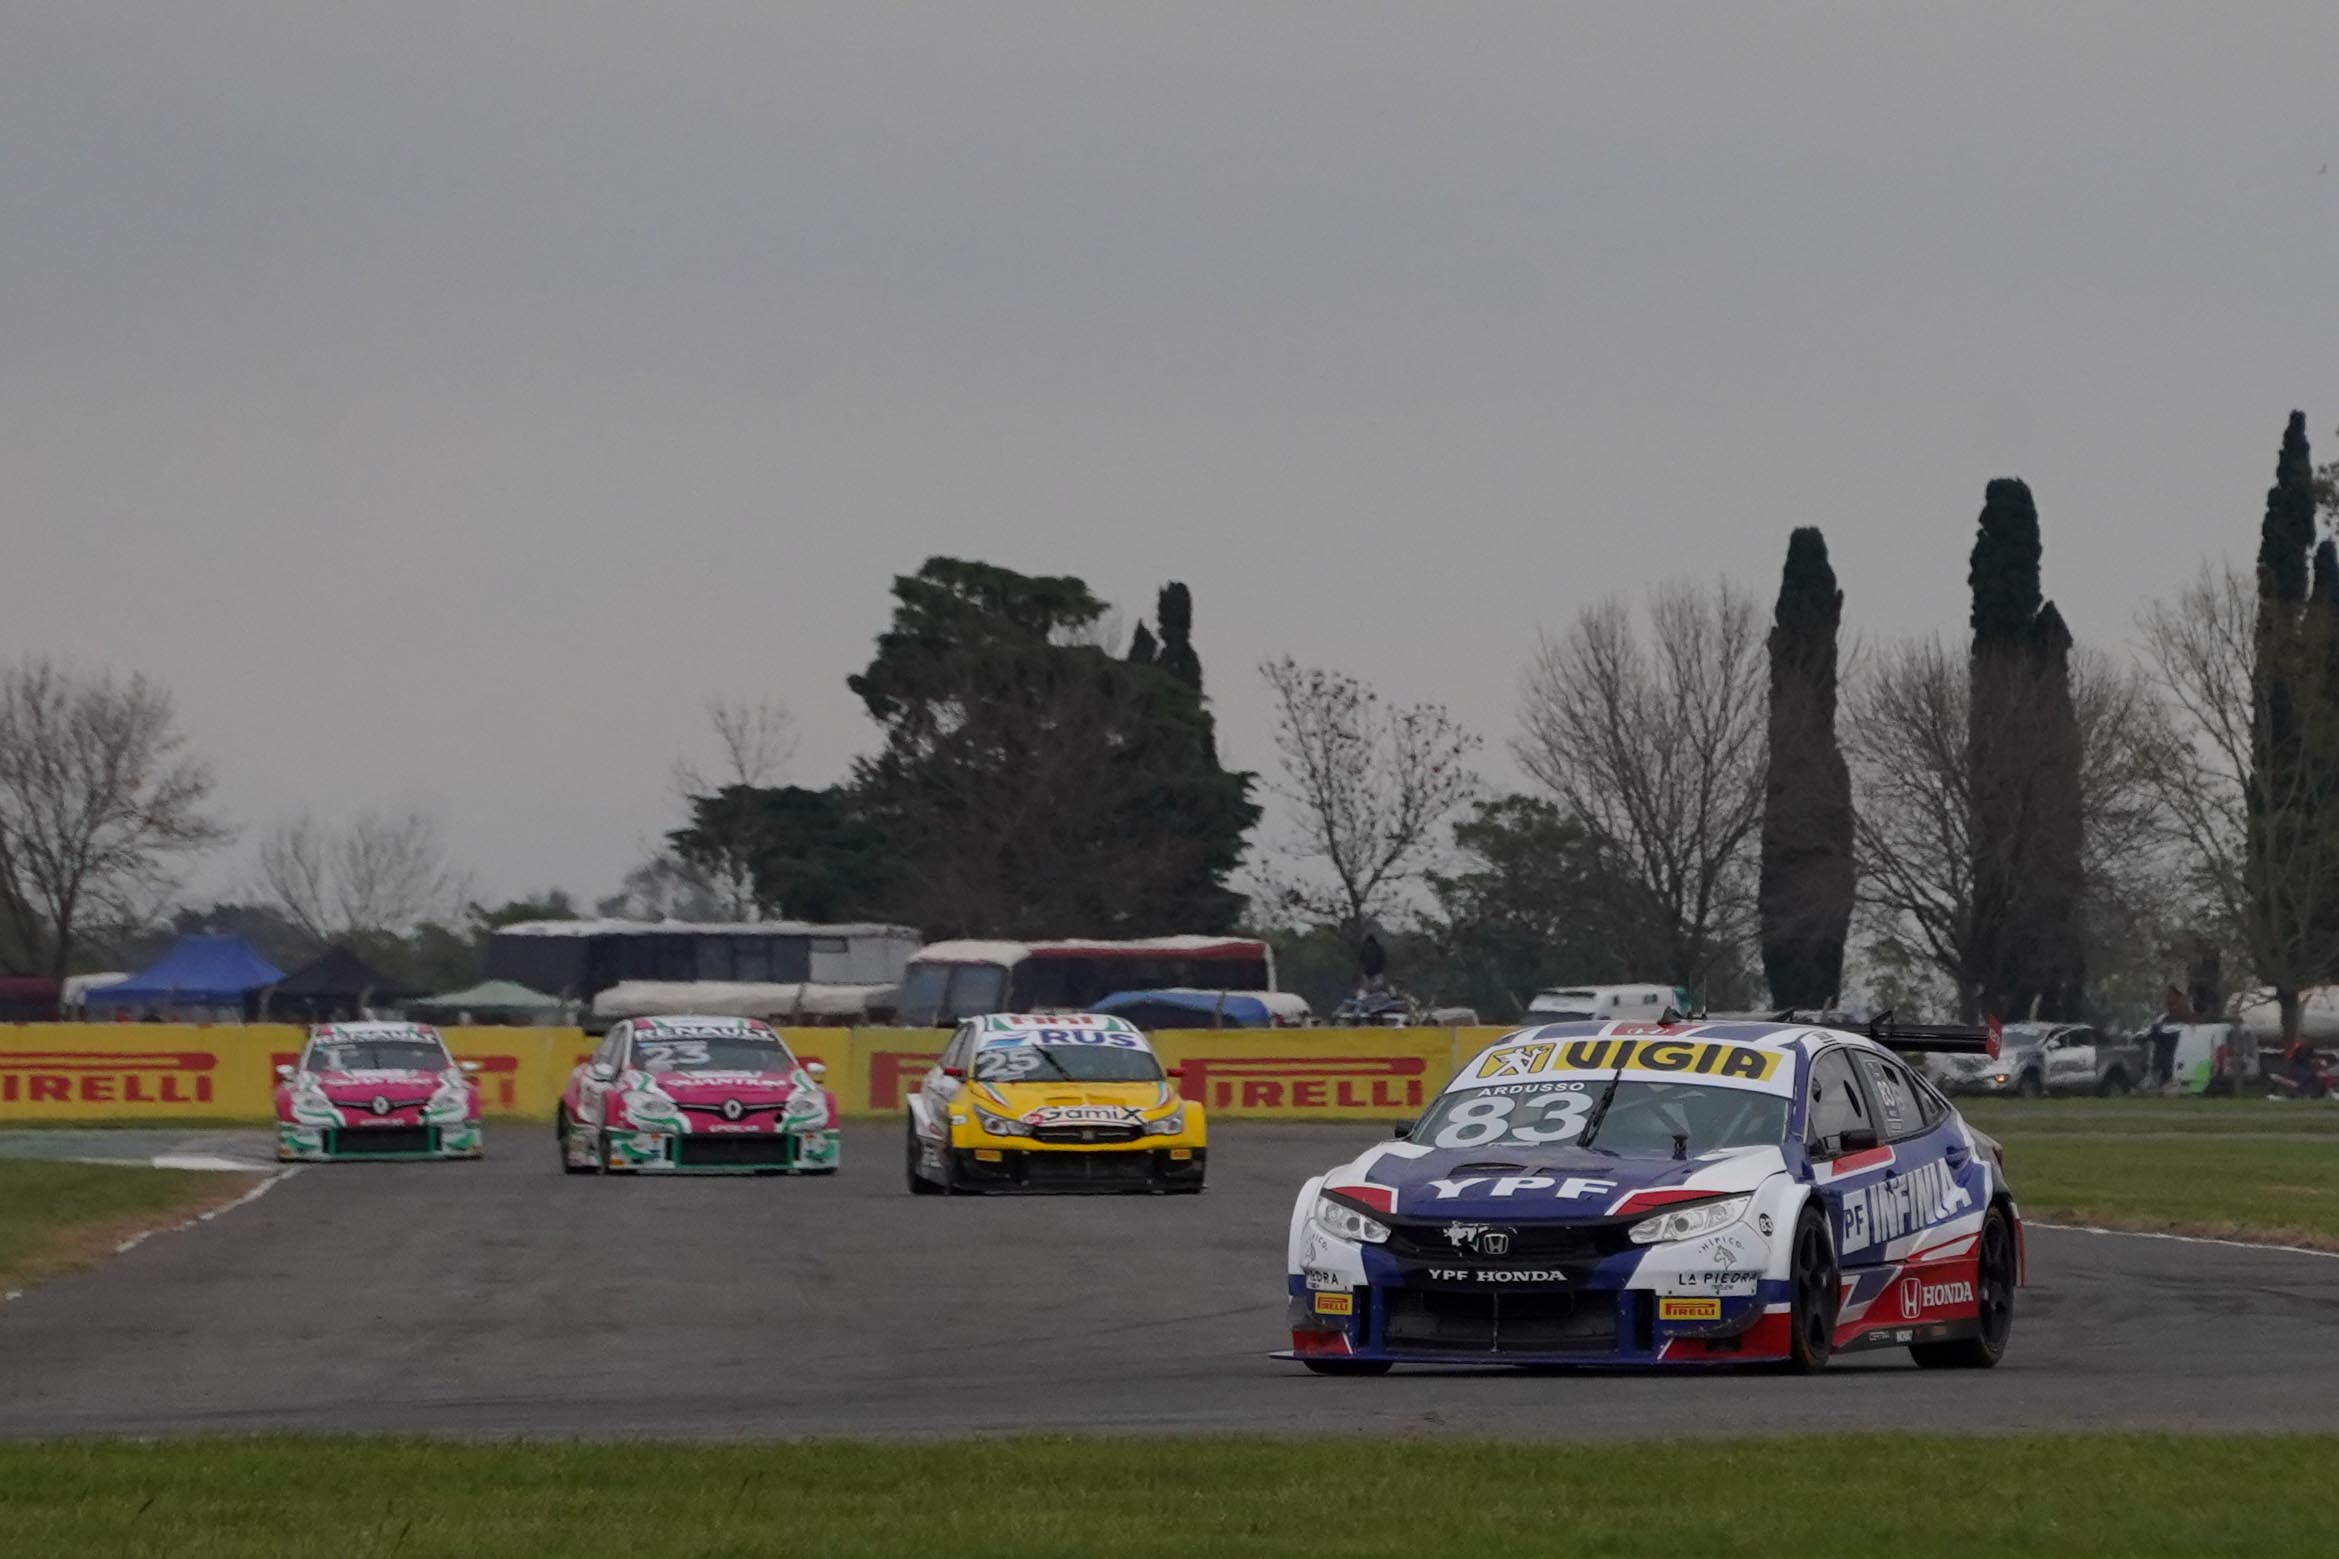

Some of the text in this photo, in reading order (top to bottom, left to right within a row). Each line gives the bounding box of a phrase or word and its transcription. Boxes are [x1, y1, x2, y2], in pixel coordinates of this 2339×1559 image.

[1039, 1029, 1137, 1048] RUS
[976, 1051, 1041, 1078] 25
[1180, 1057, 1427, 1109] PIRELLI
[1477, 1082, 1586, 1098] ARDUSSO
[1434, 1091, 1594, 1149] 83
[1427, 1176, 1618, 1200] YPF
[1428, 1268, 1568, 1283] YPF HONDA
[1704, 1271, 1758, 1284] PIEDRA
[1922, 1281, 1974, 1307] HONDA
[1665, 1303, 1716, 1317] PIRELLI
